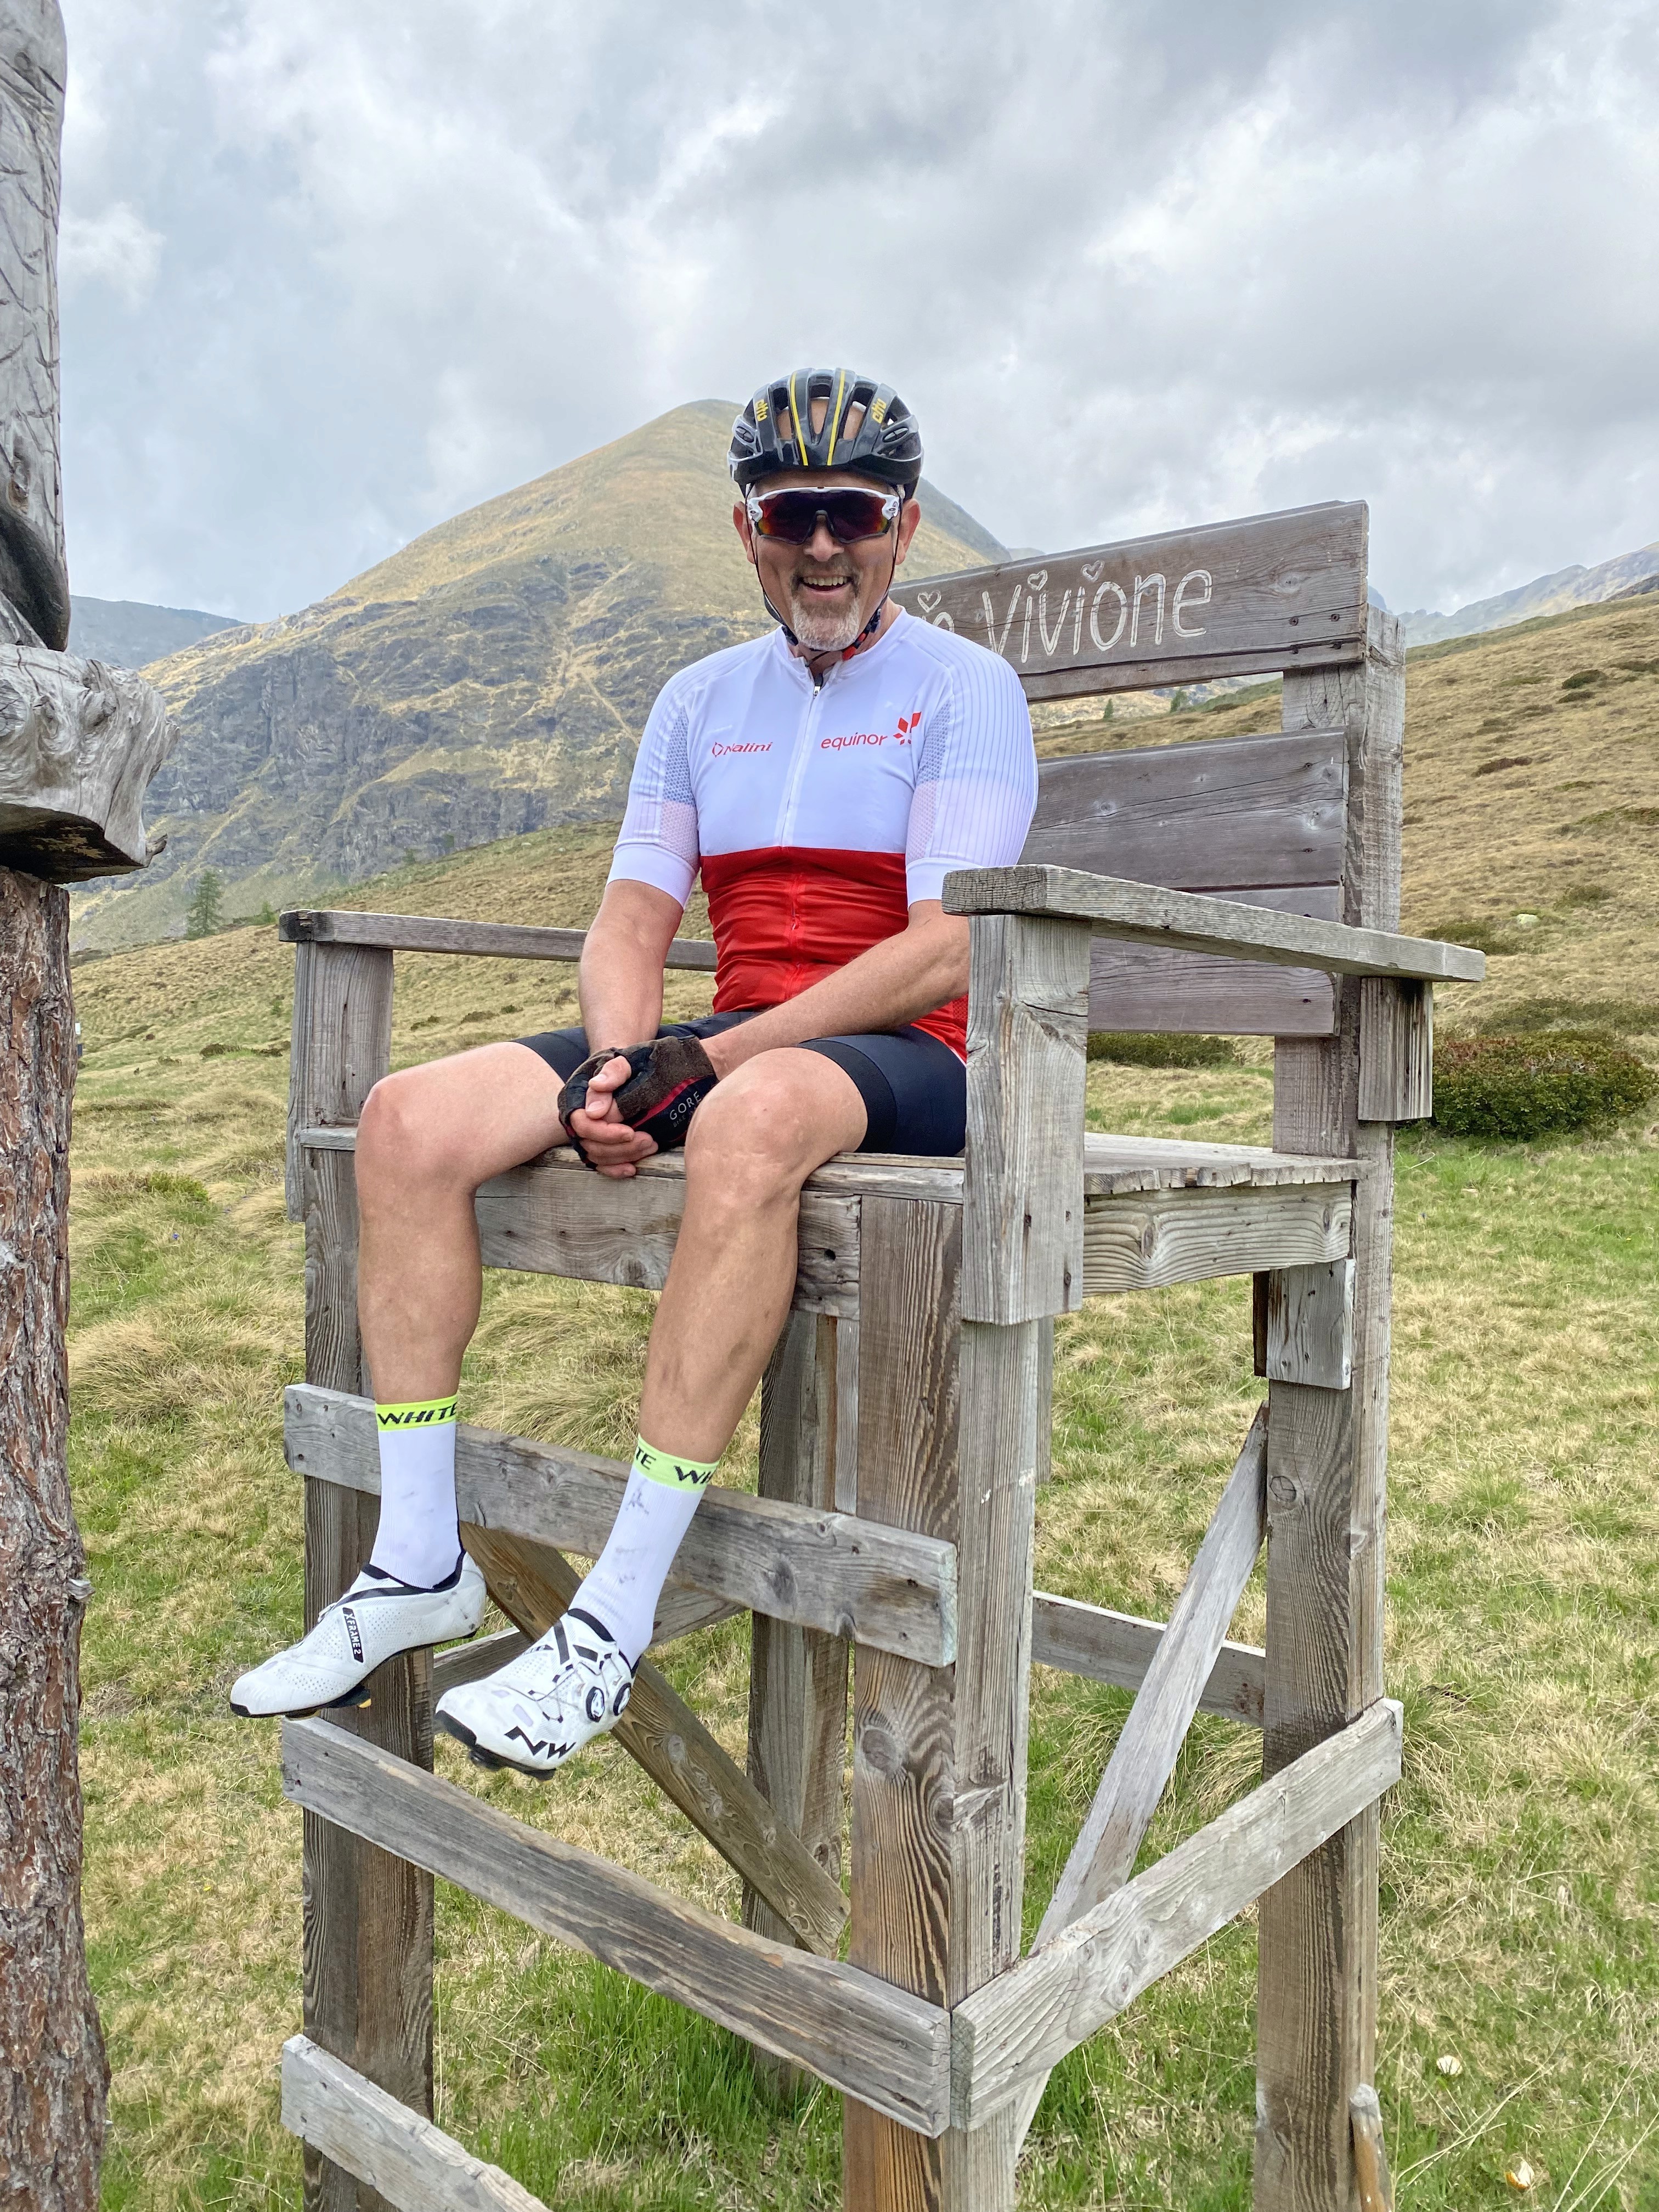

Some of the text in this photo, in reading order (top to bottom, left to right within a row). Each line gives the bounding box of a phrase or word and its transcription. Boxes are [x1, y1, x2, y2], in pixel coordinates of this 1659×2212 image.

[981, 560, 1212, 663] Vivione
[723, 742, 774, 755] Nalini
[821, 732, 888, 751] equinor
[669, 1091, 702, 1120] GORE
